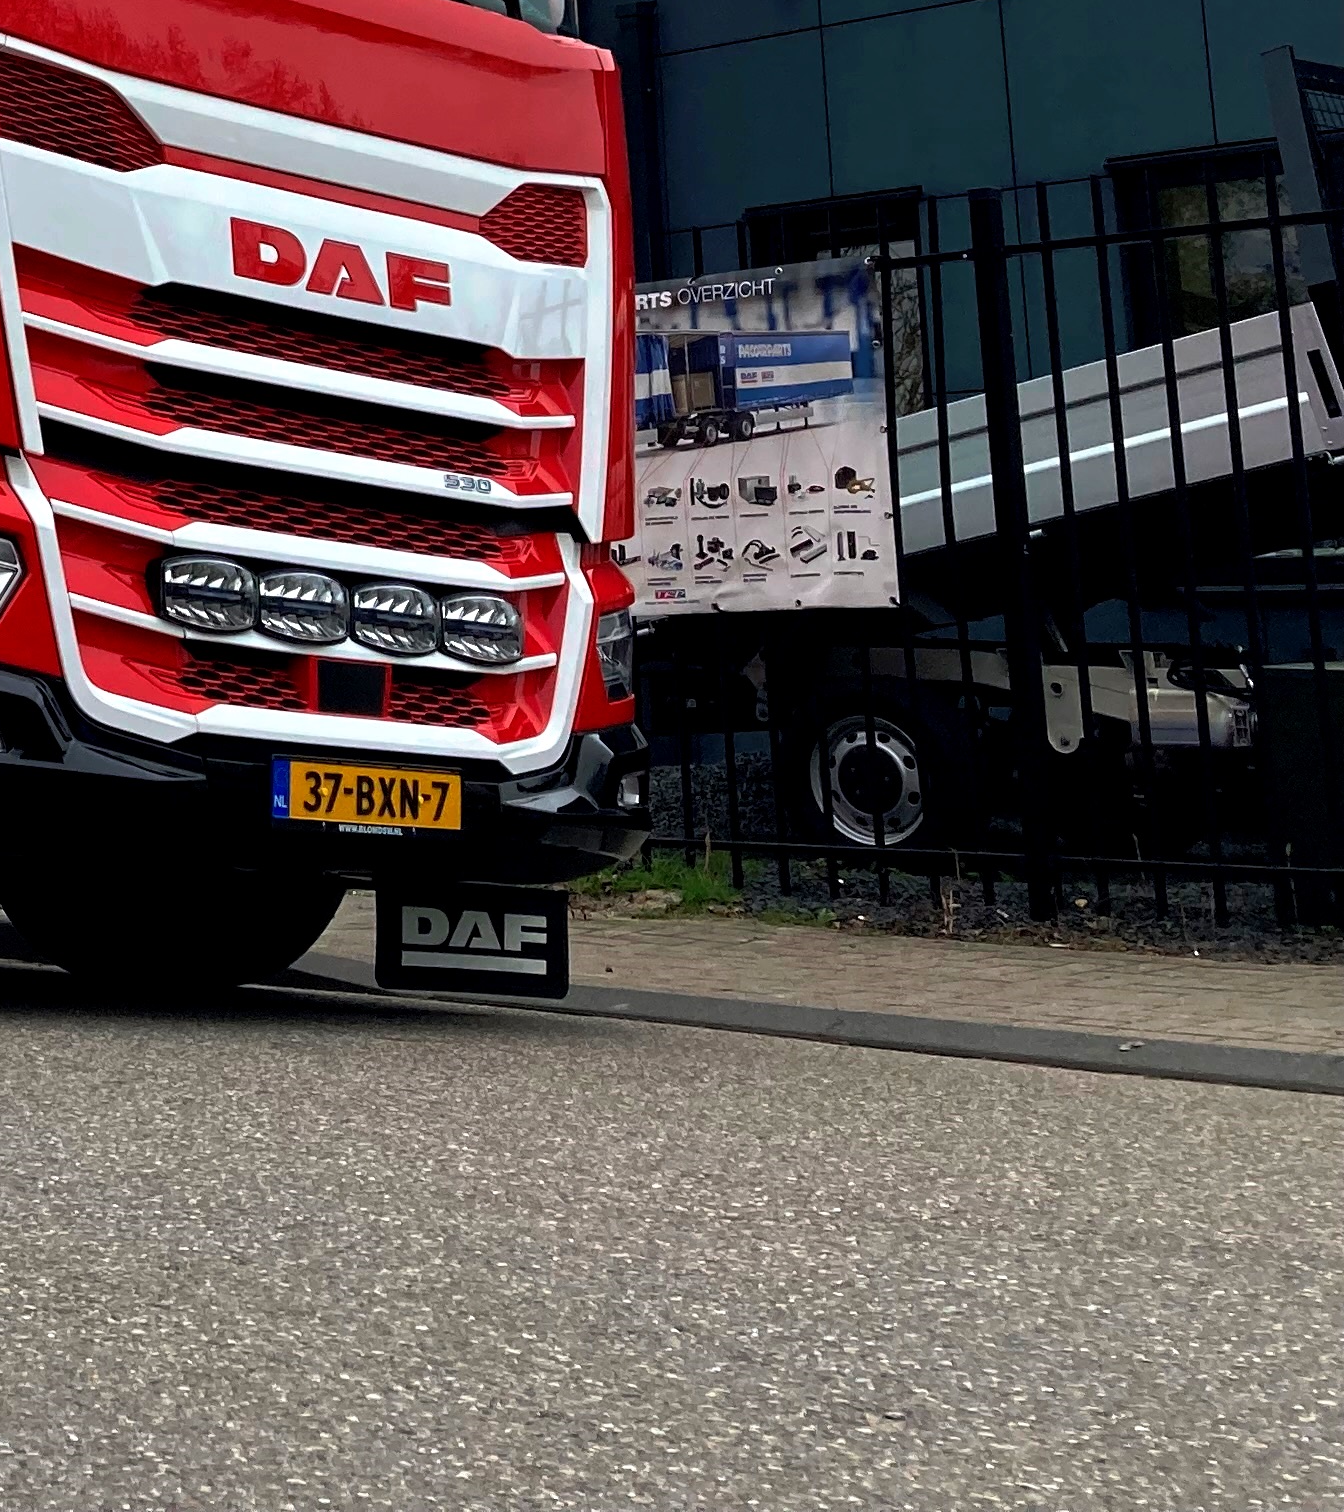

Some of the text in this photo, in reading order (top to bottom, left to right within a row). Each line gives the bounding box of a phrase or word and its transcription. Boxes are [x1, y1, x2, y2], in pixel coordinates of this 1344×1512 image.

[229, 216, 452, 313] DAF
[677, 277, 776, 305] OVERZICHT
[443, 473, 492, 494] 530
[273, 794, 288, 809] NL
[303, 770, 452, 822] 37-BXN-7
[401, 905, 548, 952] DAF
